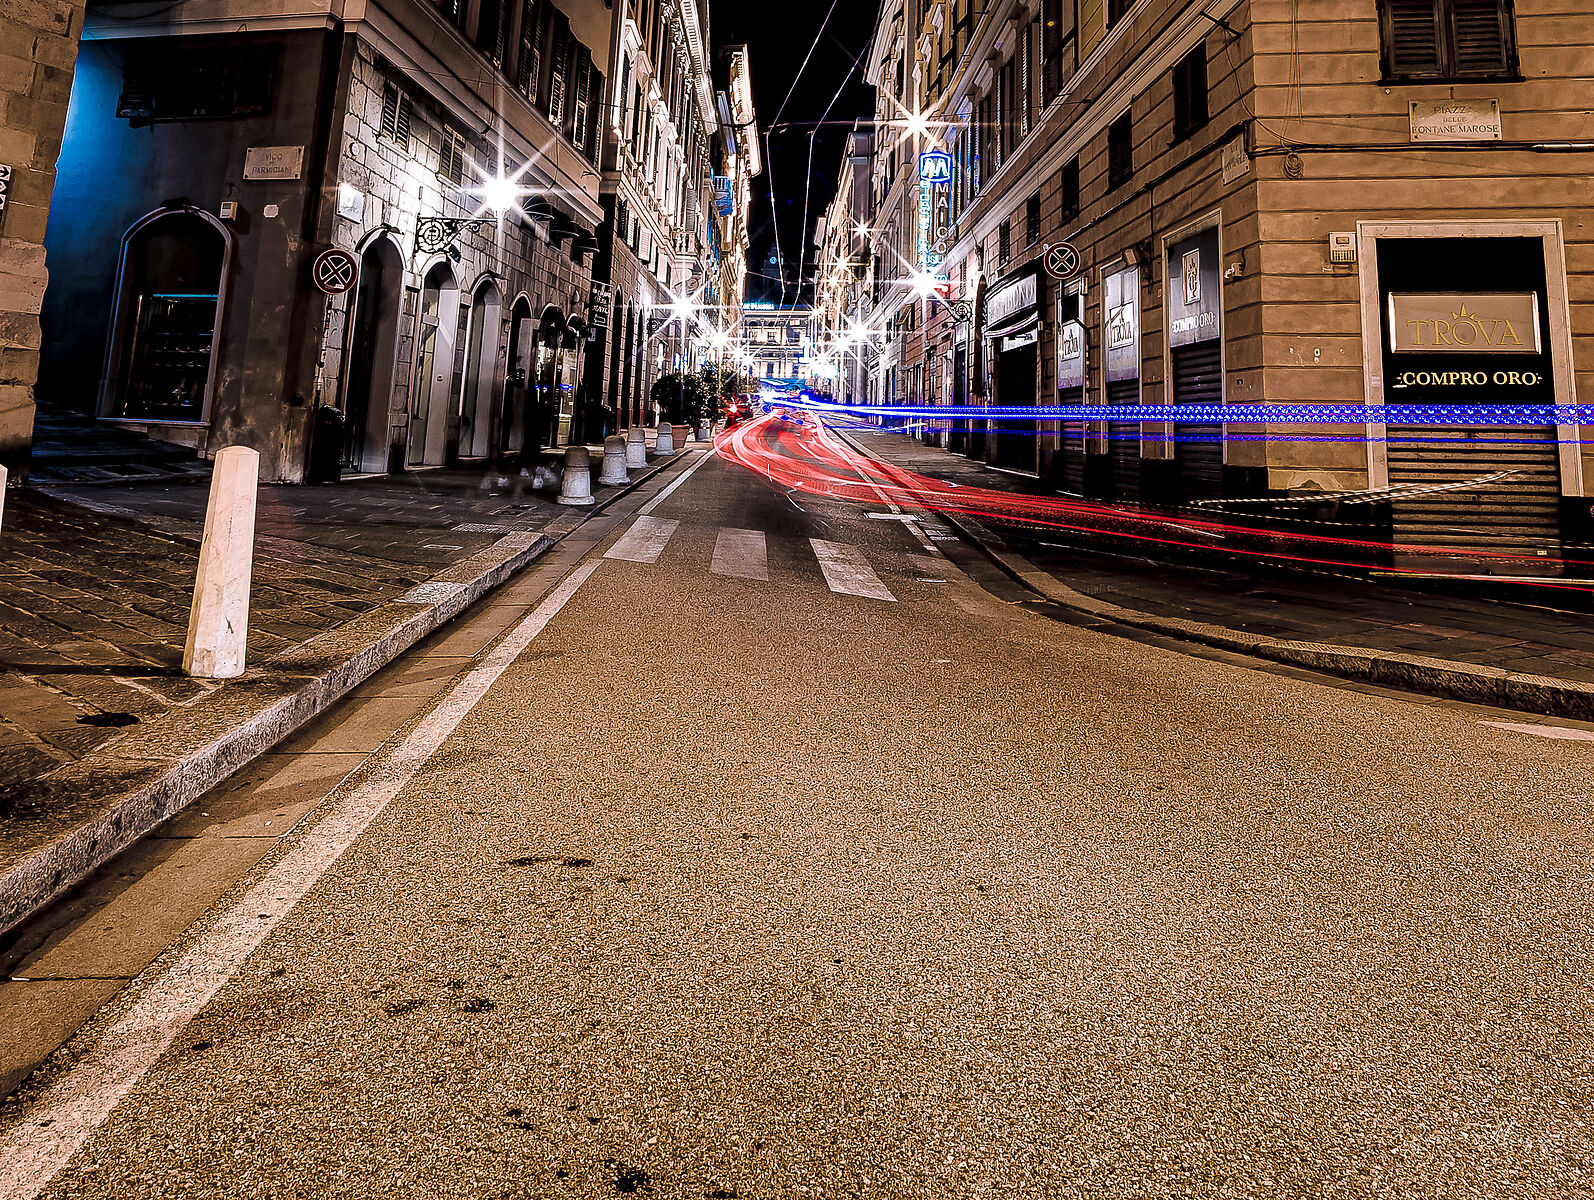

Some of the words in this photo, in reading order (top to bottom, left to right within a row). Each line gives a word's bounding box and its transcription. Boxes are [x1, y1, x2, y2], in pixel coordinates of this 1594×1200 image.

[1458, 124, 1499, 133] MAROSE
[935, 182, 950, 255] MAICO
[1199, 310, 1214, 328] ORO
[1406, 319, 1523, 346] TROVA
[1402, 371, 1488, 386] COMPRO
[1493, 371, 1537, 386] ORO
